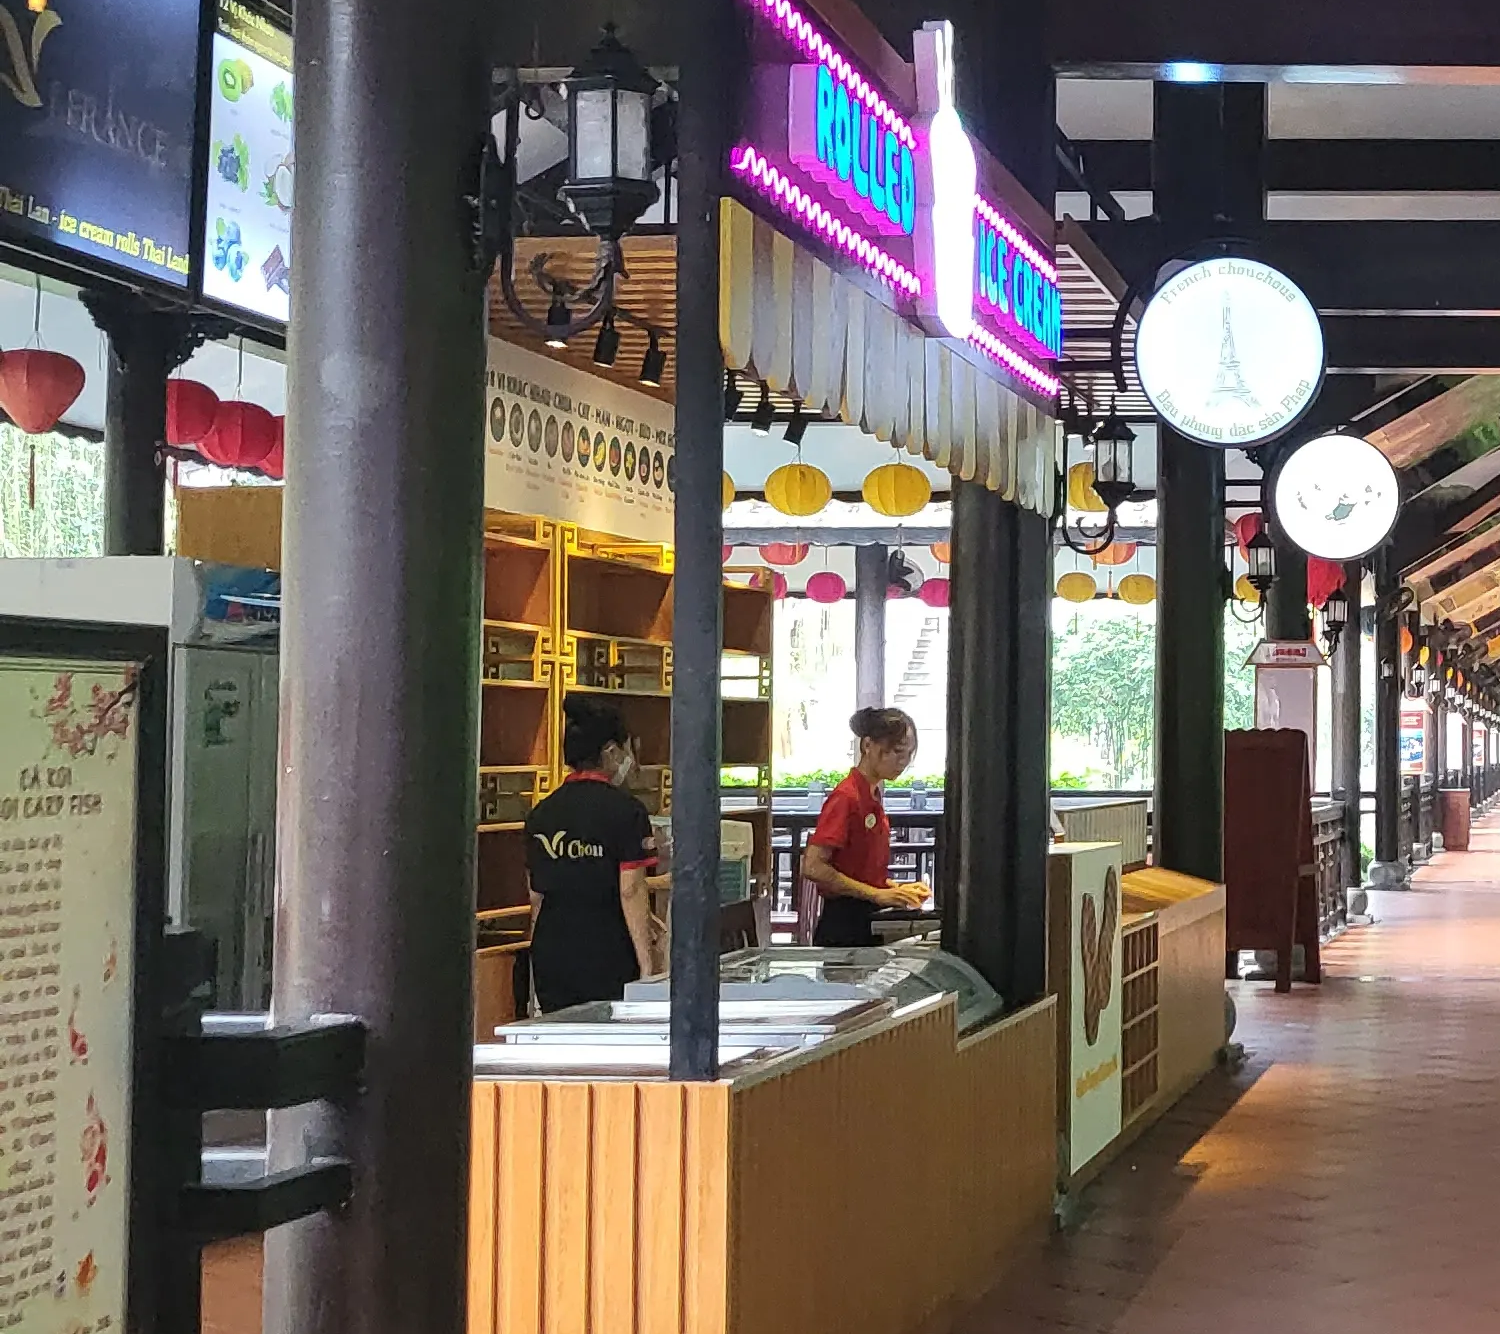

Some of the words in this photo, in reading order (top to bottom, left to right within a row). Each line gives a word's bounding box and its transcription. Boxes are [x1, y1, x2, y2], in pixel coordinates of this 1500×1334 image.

[815, 63, 915, 236] ROLLED
[58, 209, 78, 235] ice
[78, 220, 115, 248] cream
[115, 231, 141, 257] rolls
[142, 236, 166, 266] Thai
[978, 219, 1010, 315] ICE
